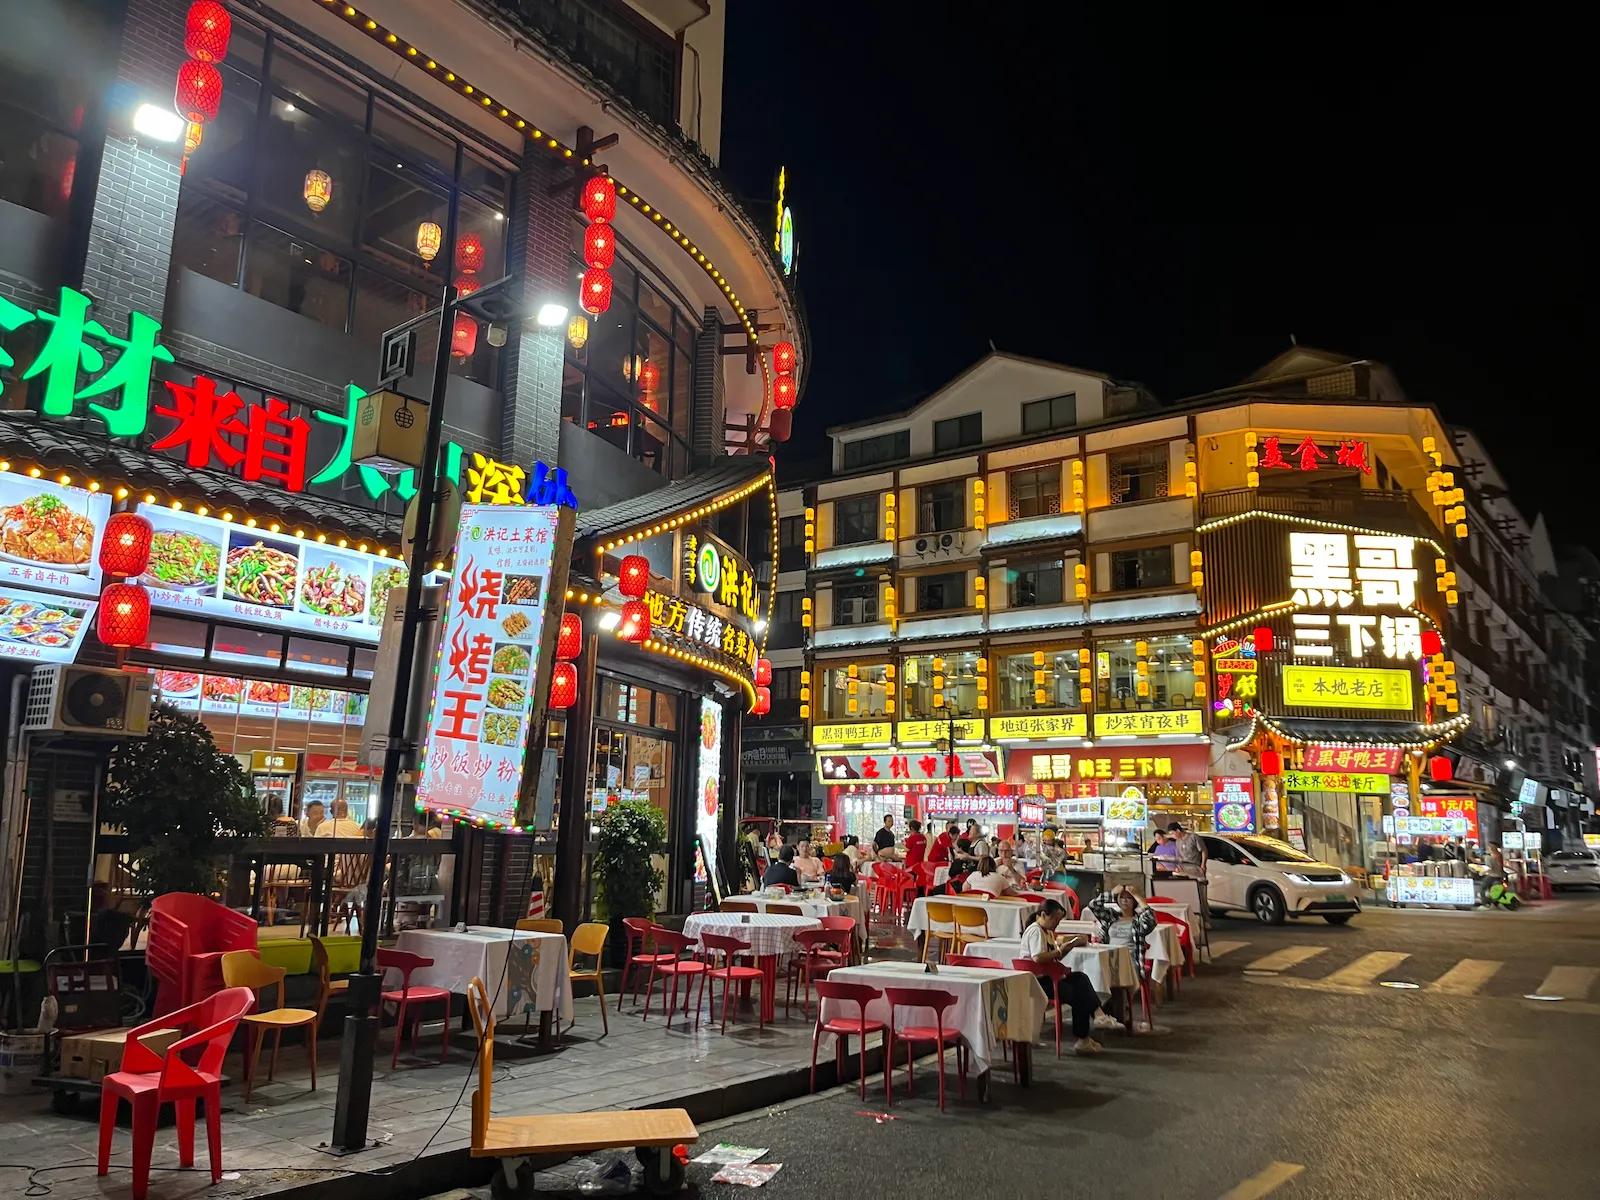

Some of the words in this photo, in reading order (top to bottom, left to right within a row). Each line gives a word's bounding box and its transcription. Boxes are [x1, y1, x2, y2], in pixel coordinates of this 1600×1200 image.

[483, 526, 549, 544] 洪记土菜馆
[8, 566, 71, 586] 五香卤牛肉
[1290, 532, 1418, 609] 黑哥
[150, 591, 205, 606] 小炒黄牛肉
[234, 603, 283, 621] 铁板鱿鱼须
[1292, 614, 1424, 661] 三下锅
[435, 554, 503, 742] 烧烤王
[1312, 676, 1385, 698] 本地老店
[906, 720, 975, 737] 三十年店
[1000, 716, 1075, 733] 地道张家界
[1105, 712, 1190, 730] 炒菜宵夜串
[821, 726, 883, 740] 黑哥鸭王店
[430, 746, 517, 783] 炒饭炒粉
[1032, 754, 1072, 780] 黑哥
[1078, 758, 1113, 779] 鸭王
[1119, 757, 1173, 779] 三下锅
[1316, 749, 1387, 769] 黑哥鸭王
